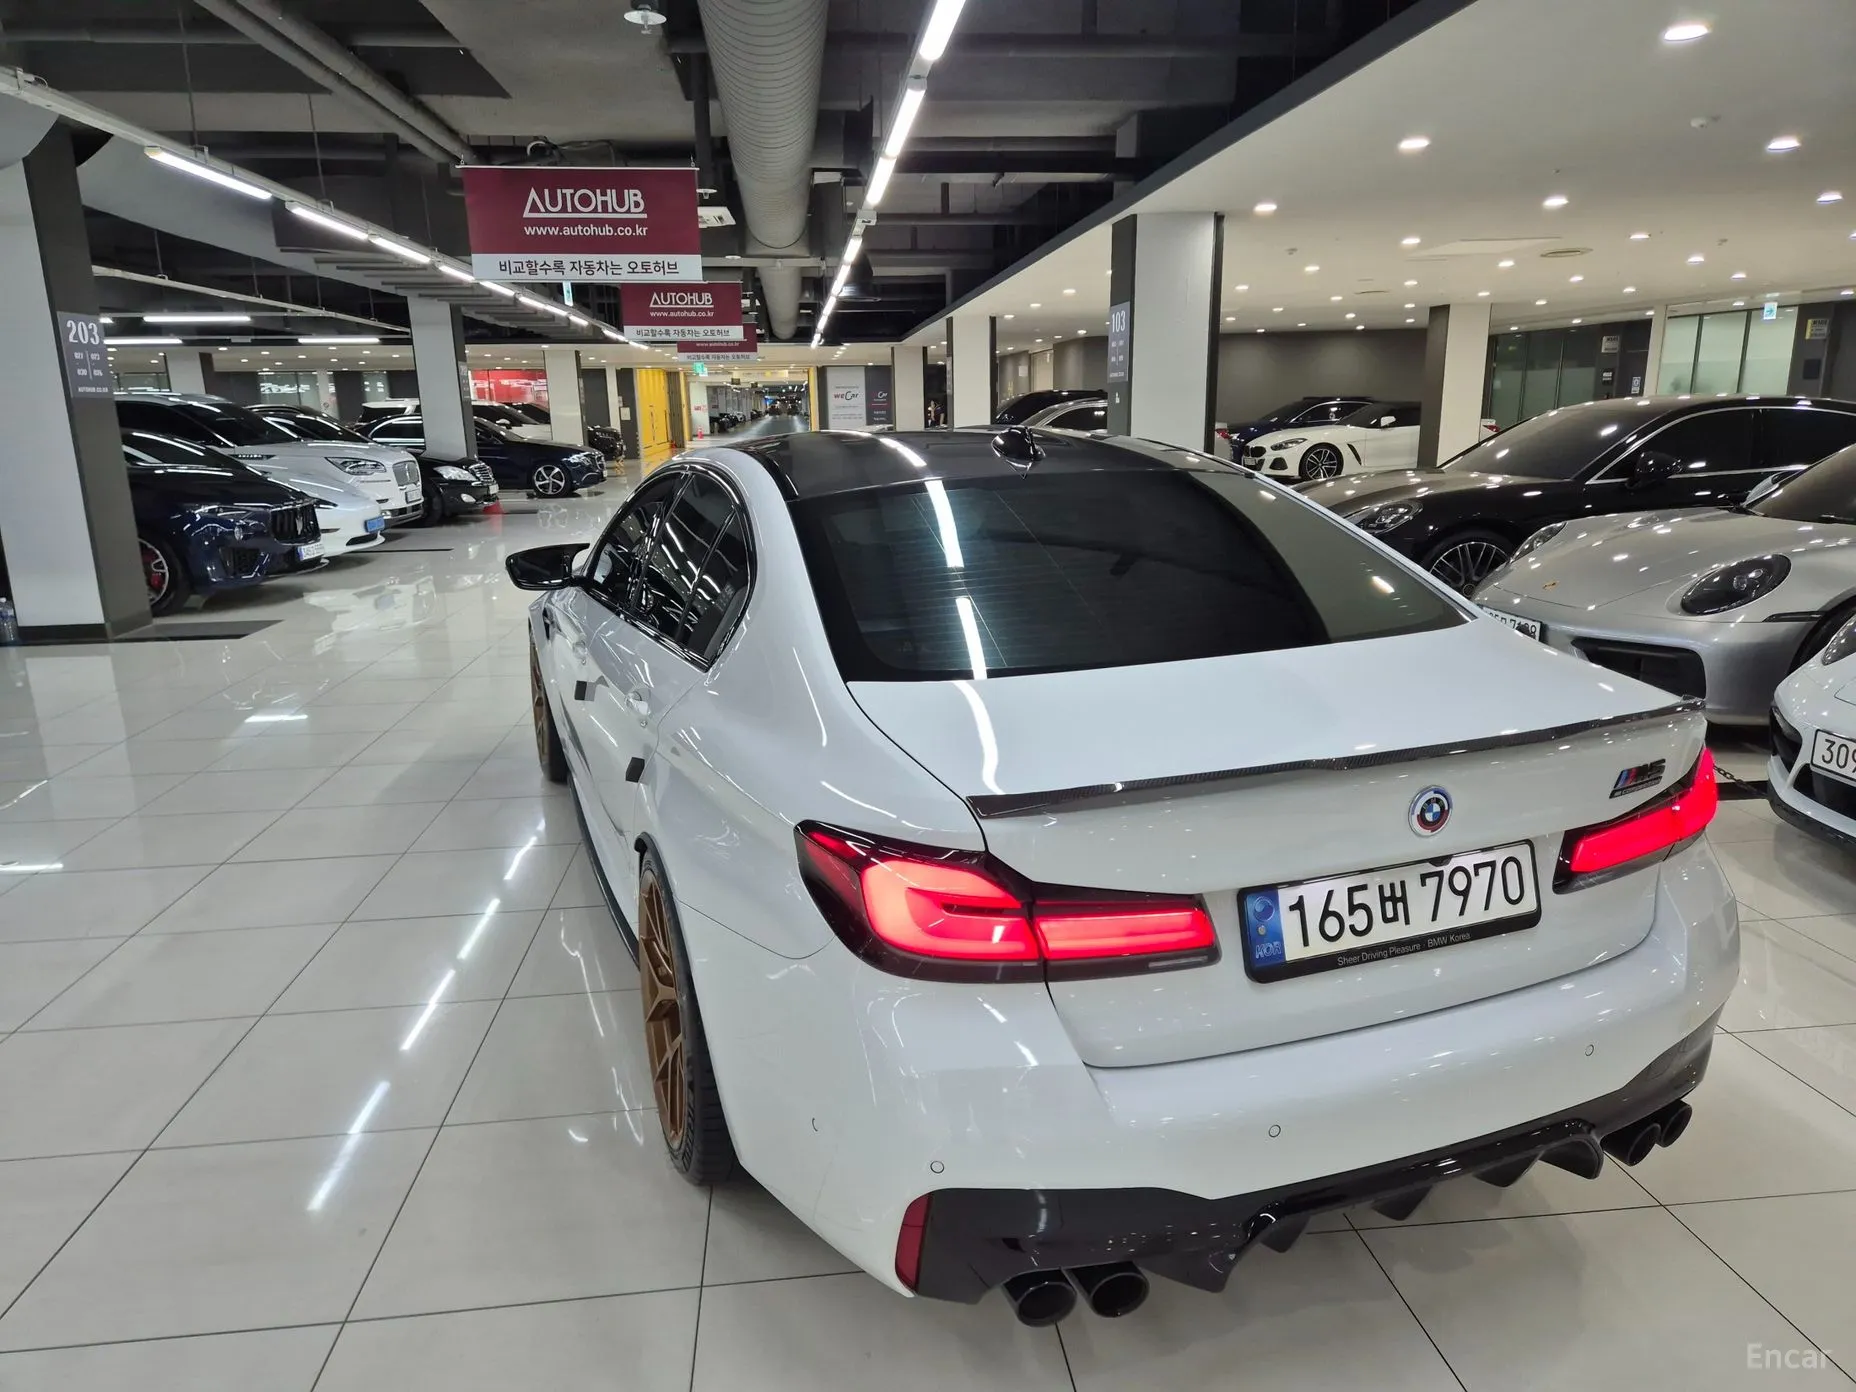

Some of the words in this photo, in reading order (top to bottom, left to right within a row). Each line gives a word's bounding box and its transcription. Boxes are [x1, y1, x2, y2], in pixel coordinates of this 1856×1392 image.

[523, 187, 647, 218] AUTOHUB
[524, 224, 648, 236] www.autohub.co.kr
[499, 260, 566, 275] 비교할수록
[570, 260, 623, 276] 자동차는
[627, 261, 680, 276] 오토허브
[649, 292, 714, 308] AUTOHUB
[650, 310, 714, 318] www.autohub.co.kr
[1112, 310, 1126, 333] 103
[66, 320, 100, 345] 203
[1288, 880, 1411, 948] 165버
[1420, 856, 1525, 922] 7970
[1255, 941, 1282, 959] KOR
[1337, 954, 1360, 966] Sheer
[1361, 949, 1389, 961] Driving
[1389, 943, 1421, 956] Pleasure
[1427, 937, 1448, 948] BMW
[1449, 932, 1471, 943] Korea
